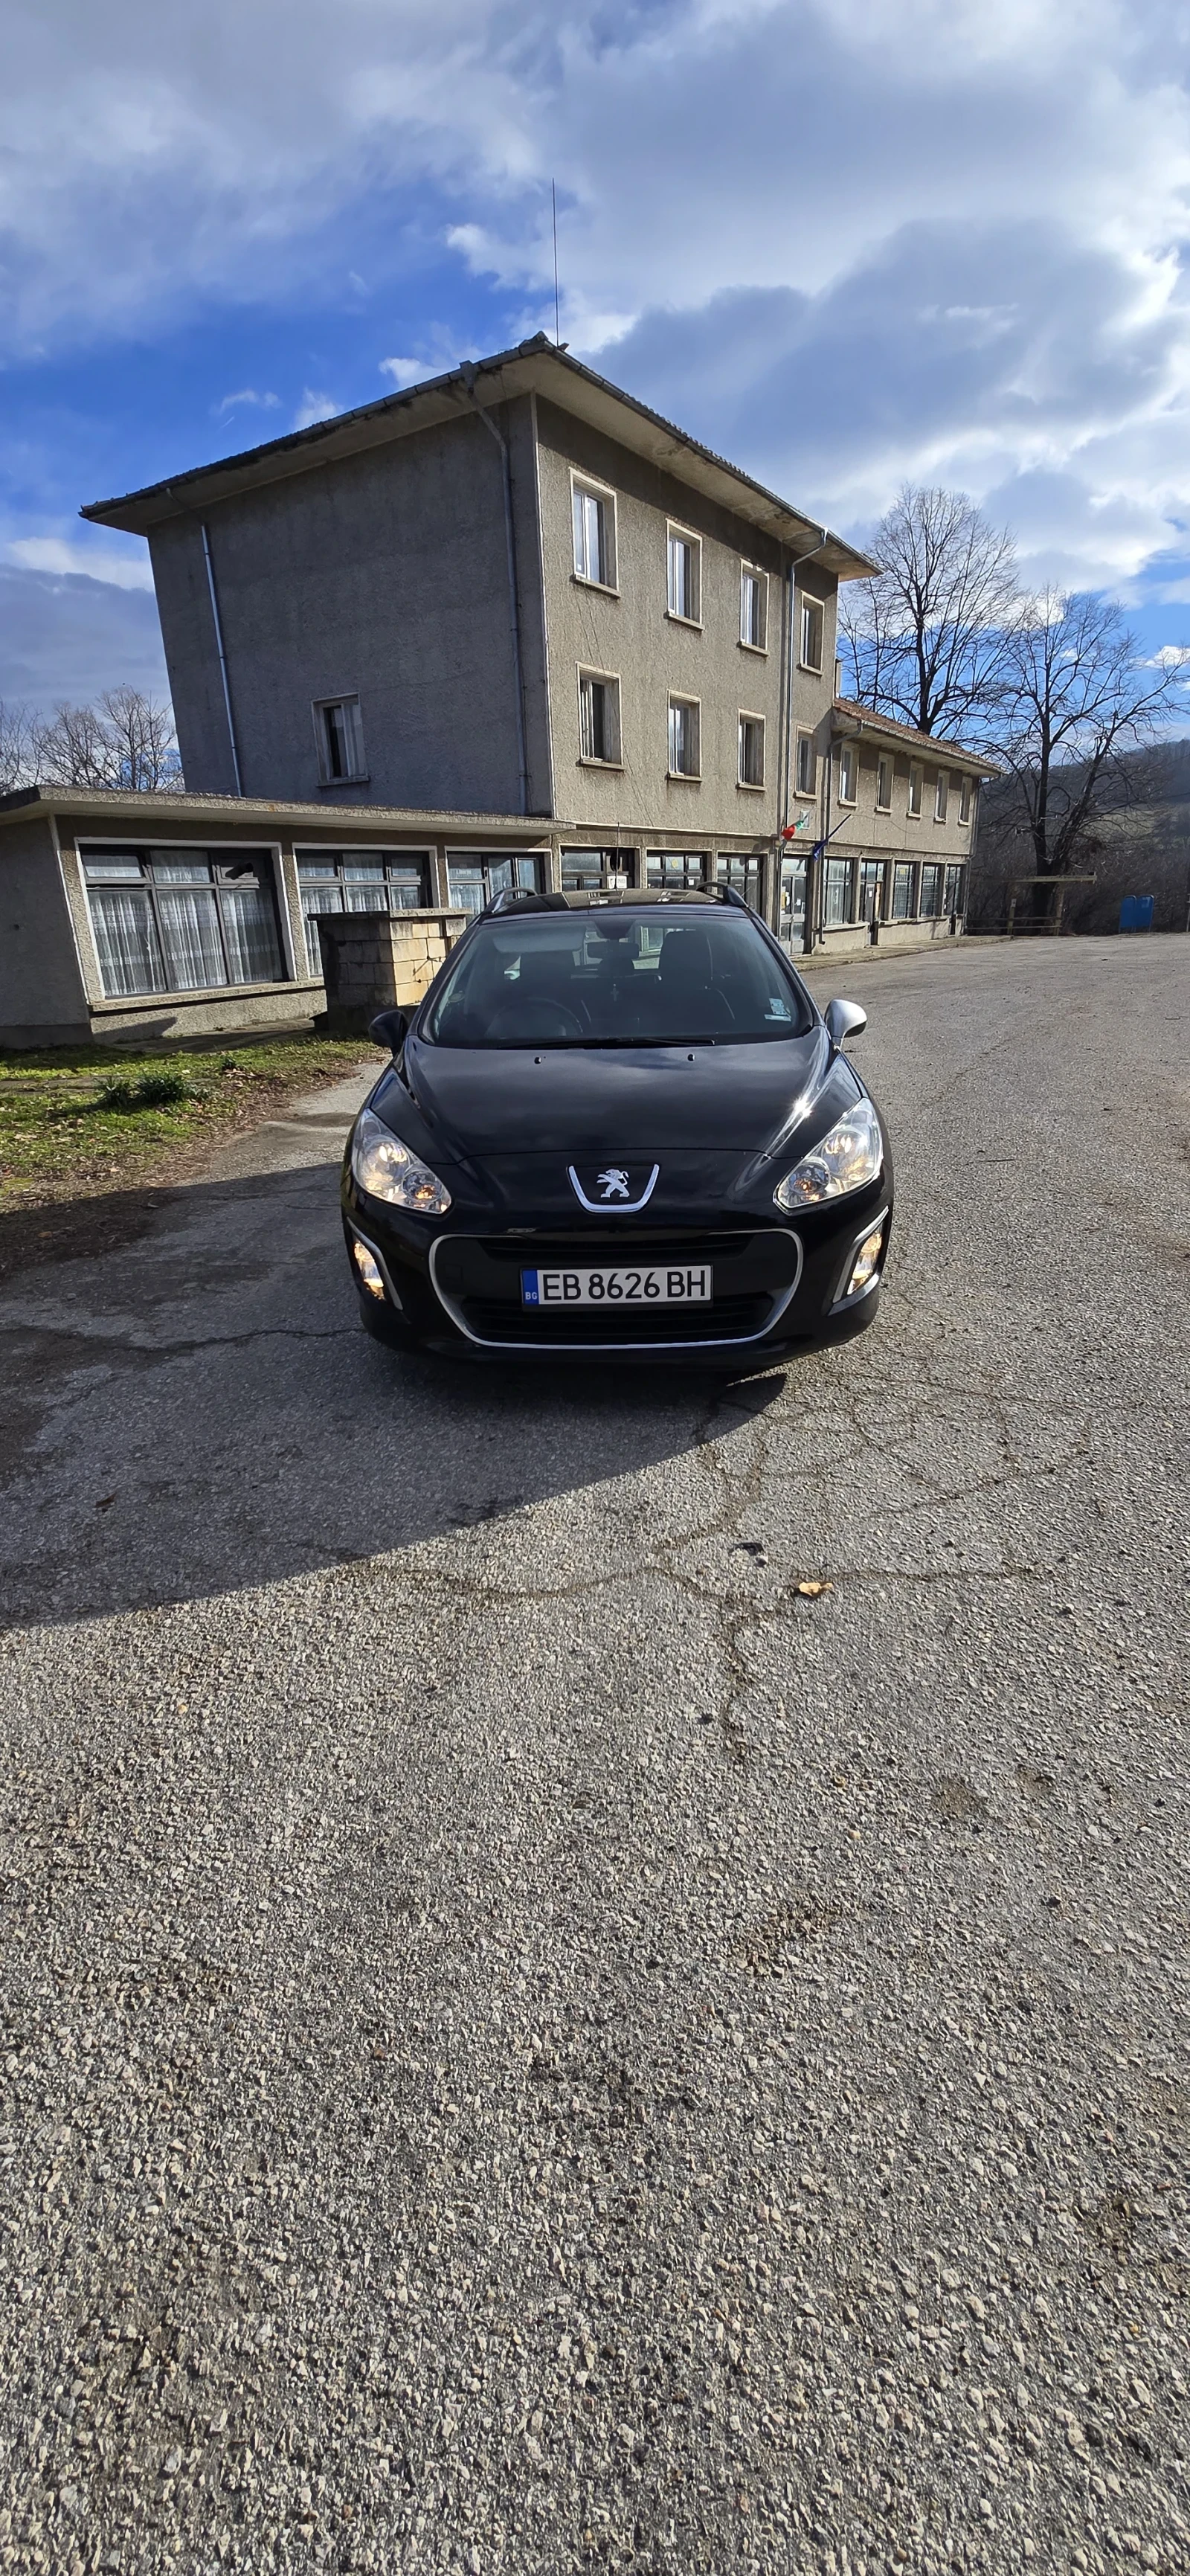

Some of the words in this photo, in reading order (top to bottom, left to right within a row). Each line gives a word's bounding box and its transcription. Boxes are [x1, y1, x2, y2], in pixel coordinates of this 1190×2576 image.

[542, 1273, 582, 1301] EB
[588, 1271, 660, 1300] 8626
[666, 1270, 706, 1298] BH
[525, 1292, 538, 1300] BG
